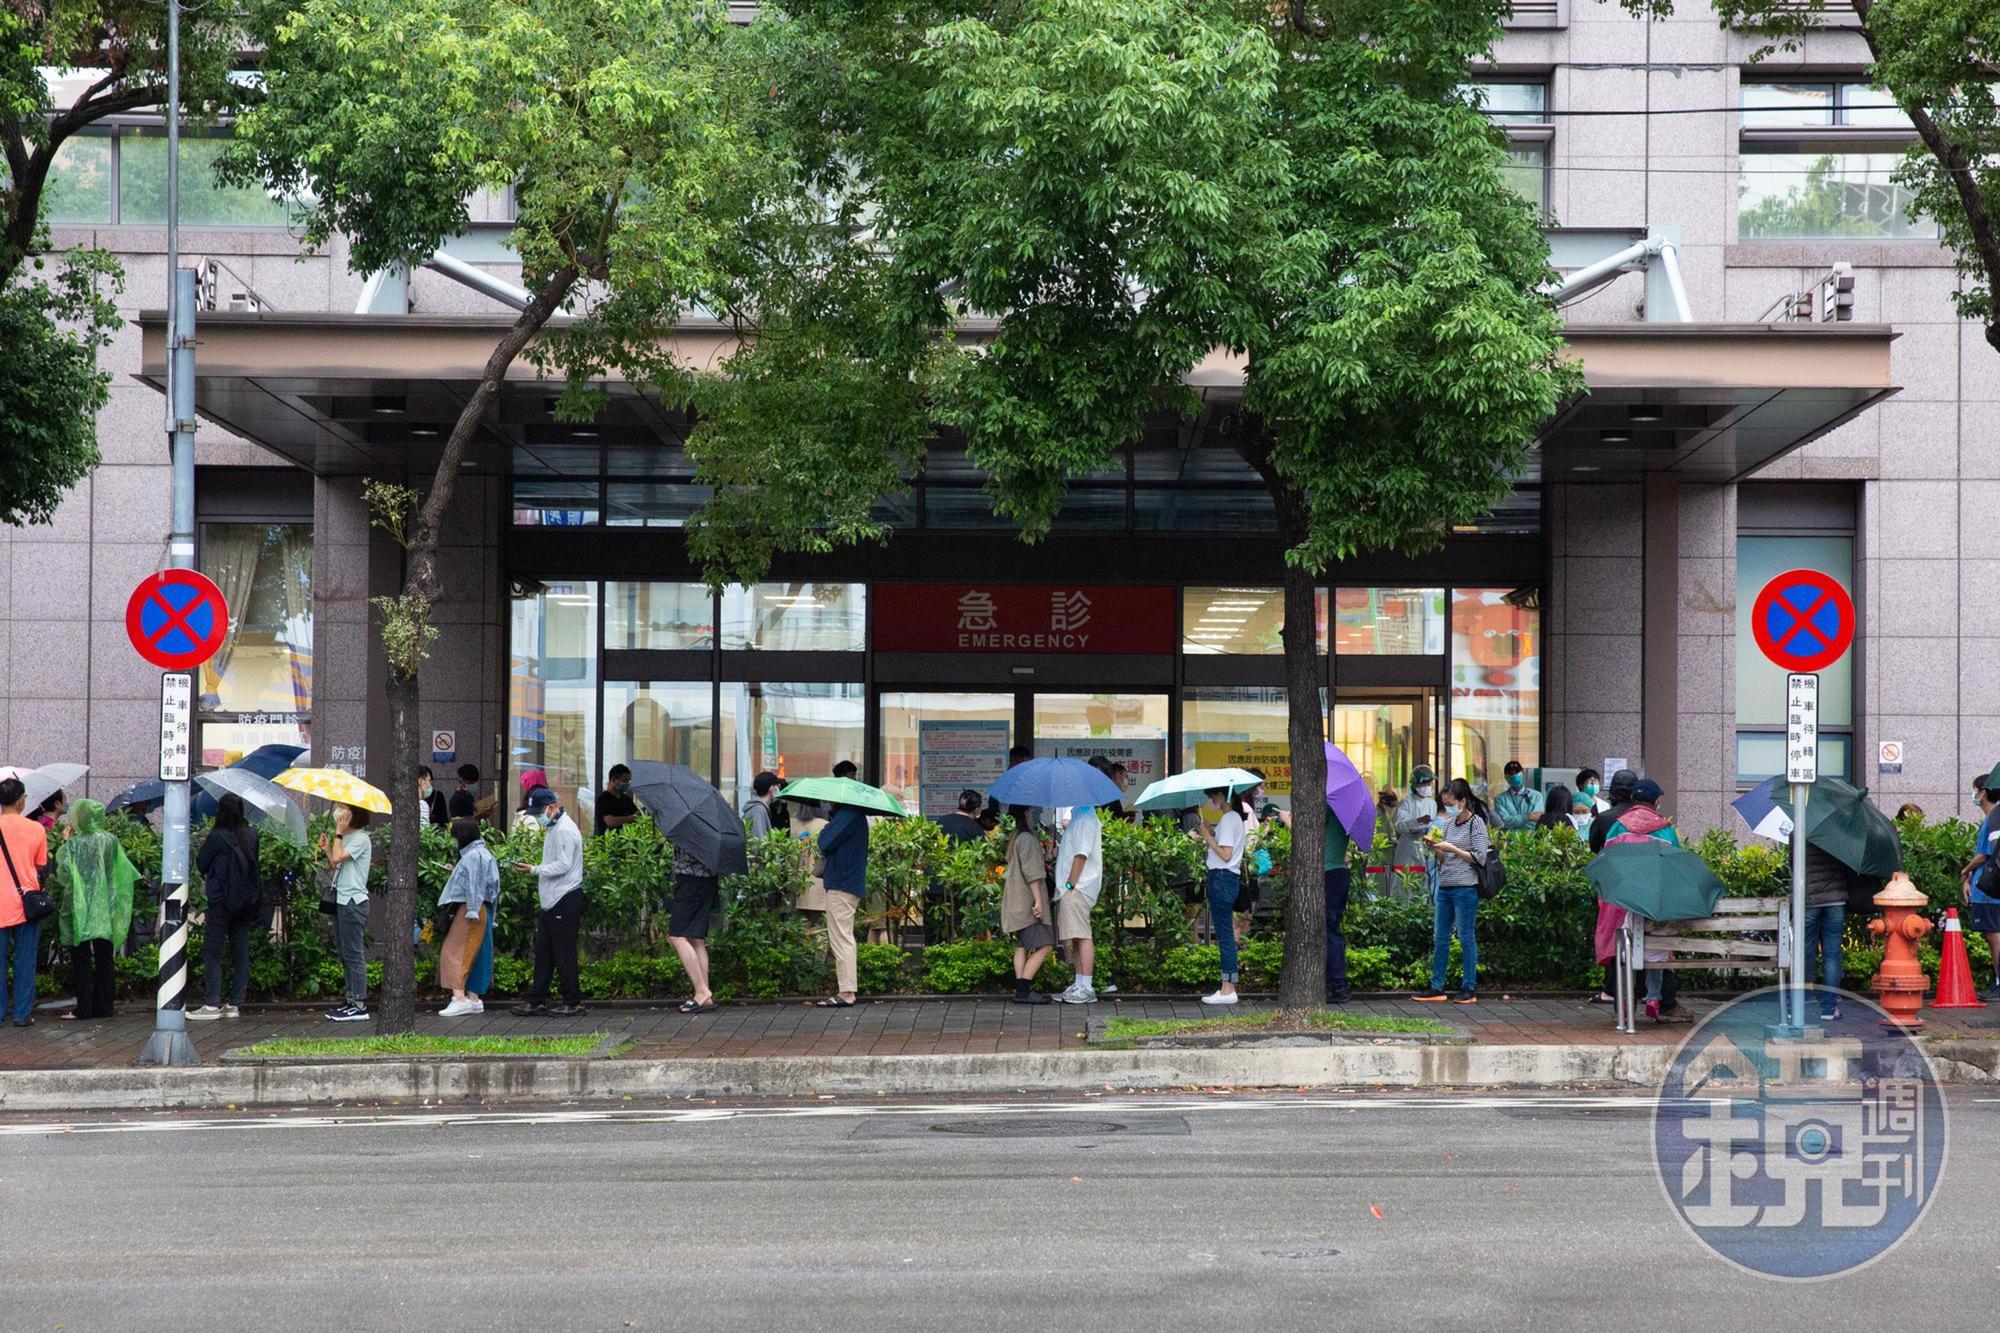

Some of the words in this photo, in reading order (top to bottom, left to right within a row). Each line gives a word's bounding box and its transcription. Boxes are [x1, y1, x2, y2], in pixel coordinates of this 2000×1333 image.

[957, 590, 1093, 631] 急診
[958, 634, 1090, 648] EMERGENCY
[163, 677, 177, 776] 禁止臨時停車
[175, 677, 189, 777] 機車待轉區
[238, 713, 299, 726] 防疫門診
[1066, 747, 1134, 757] 因應政府防疫需要
[1790, 678, 1802, 778] 禁止臨時停車
[1803, 679, 1814, 779] 機車待轉區
